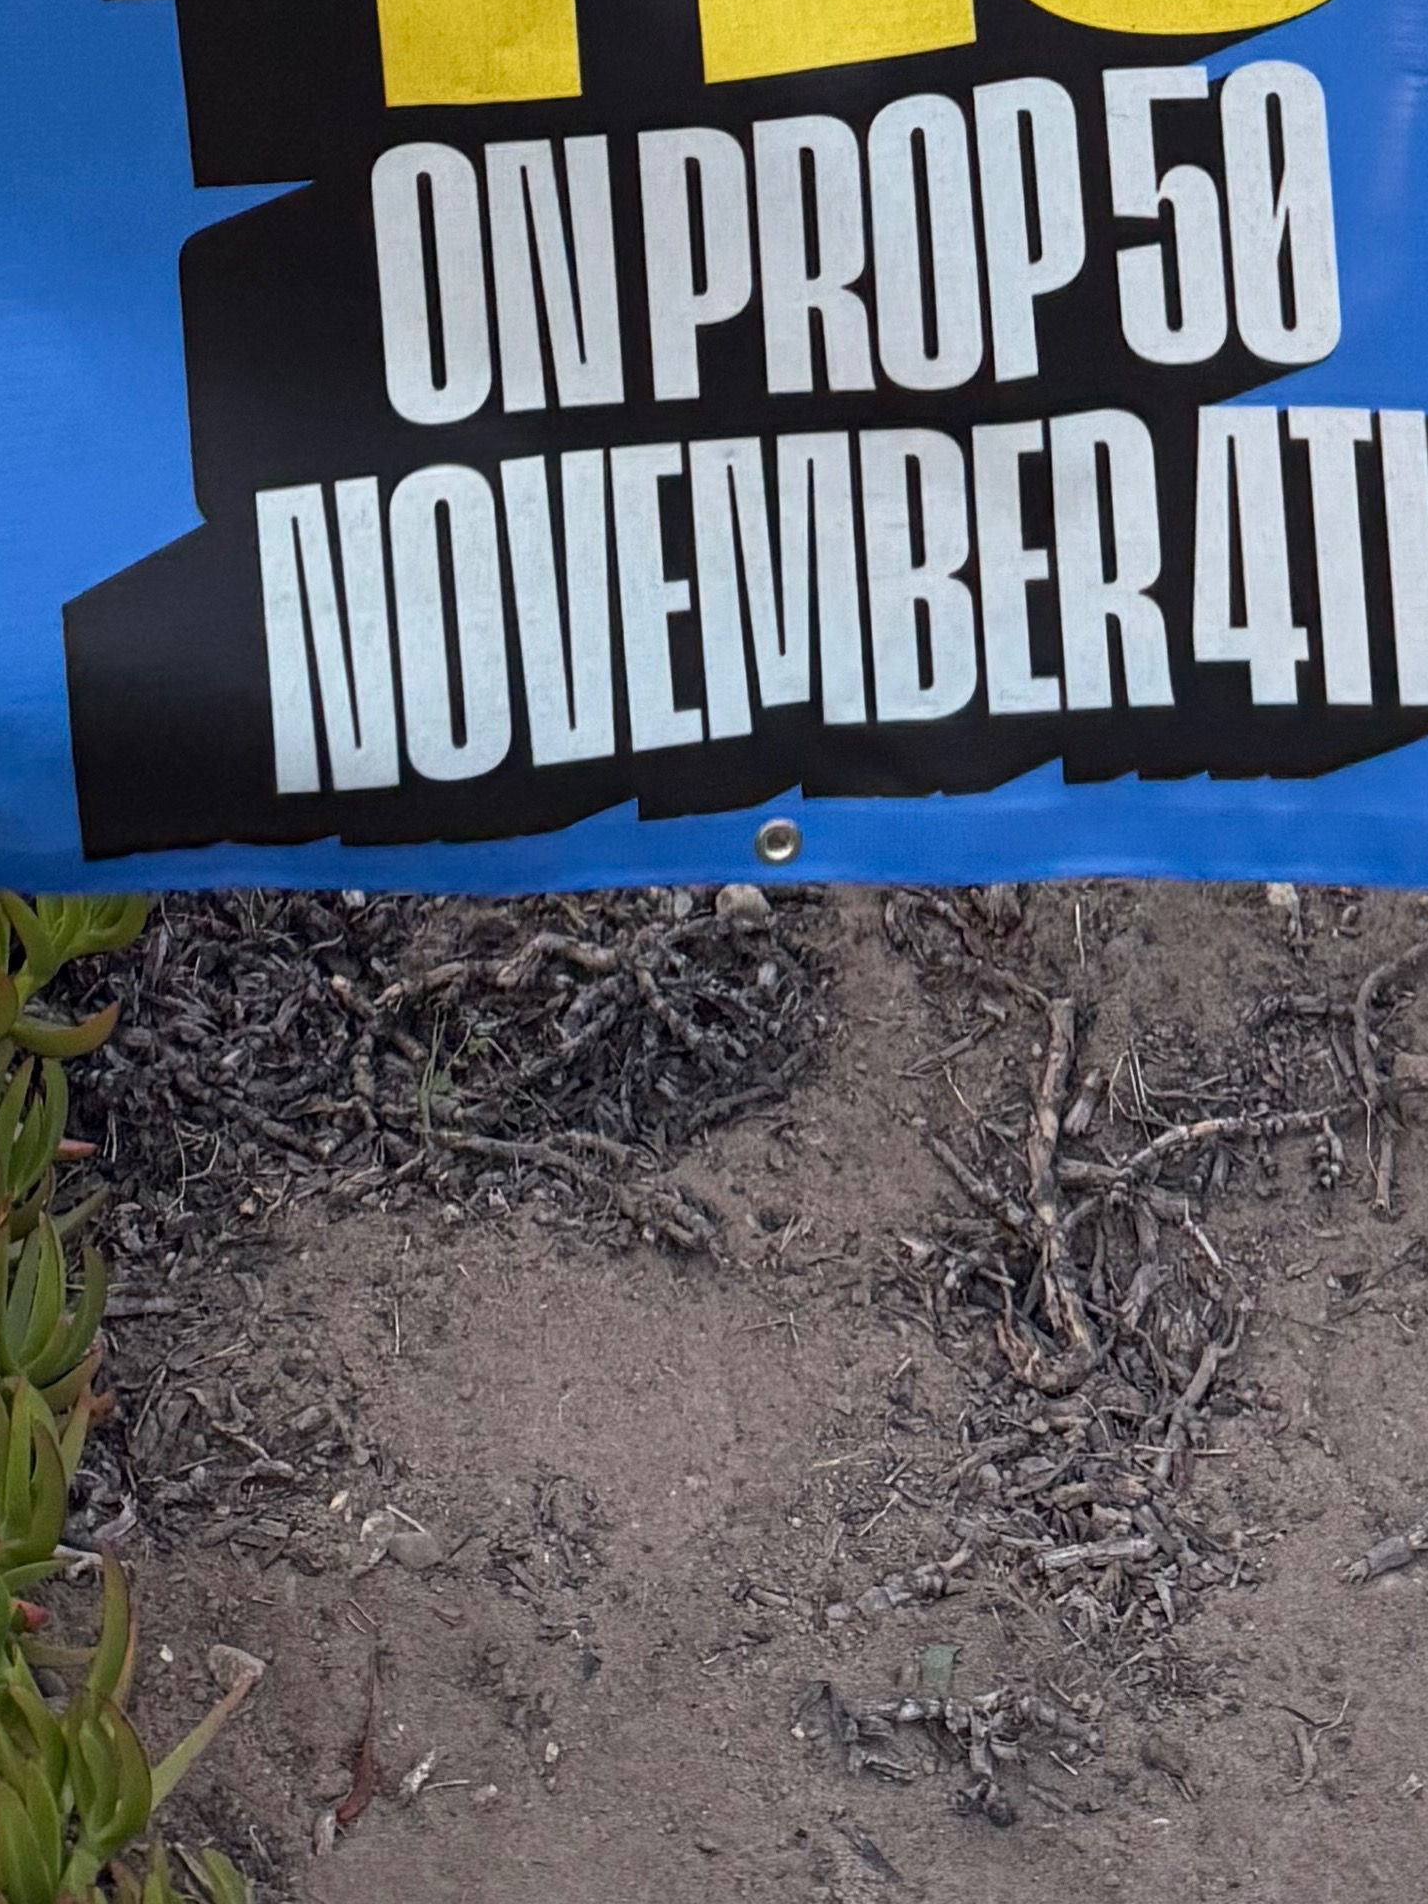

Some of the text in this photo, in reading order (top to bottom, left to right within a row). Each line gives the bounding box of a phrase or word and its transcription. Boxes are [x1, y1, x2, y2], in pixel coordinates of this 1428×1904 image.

[372, 59, 1342, 426] ON PROP 50
[256, 407, 1175, 795] NOVEMBER
